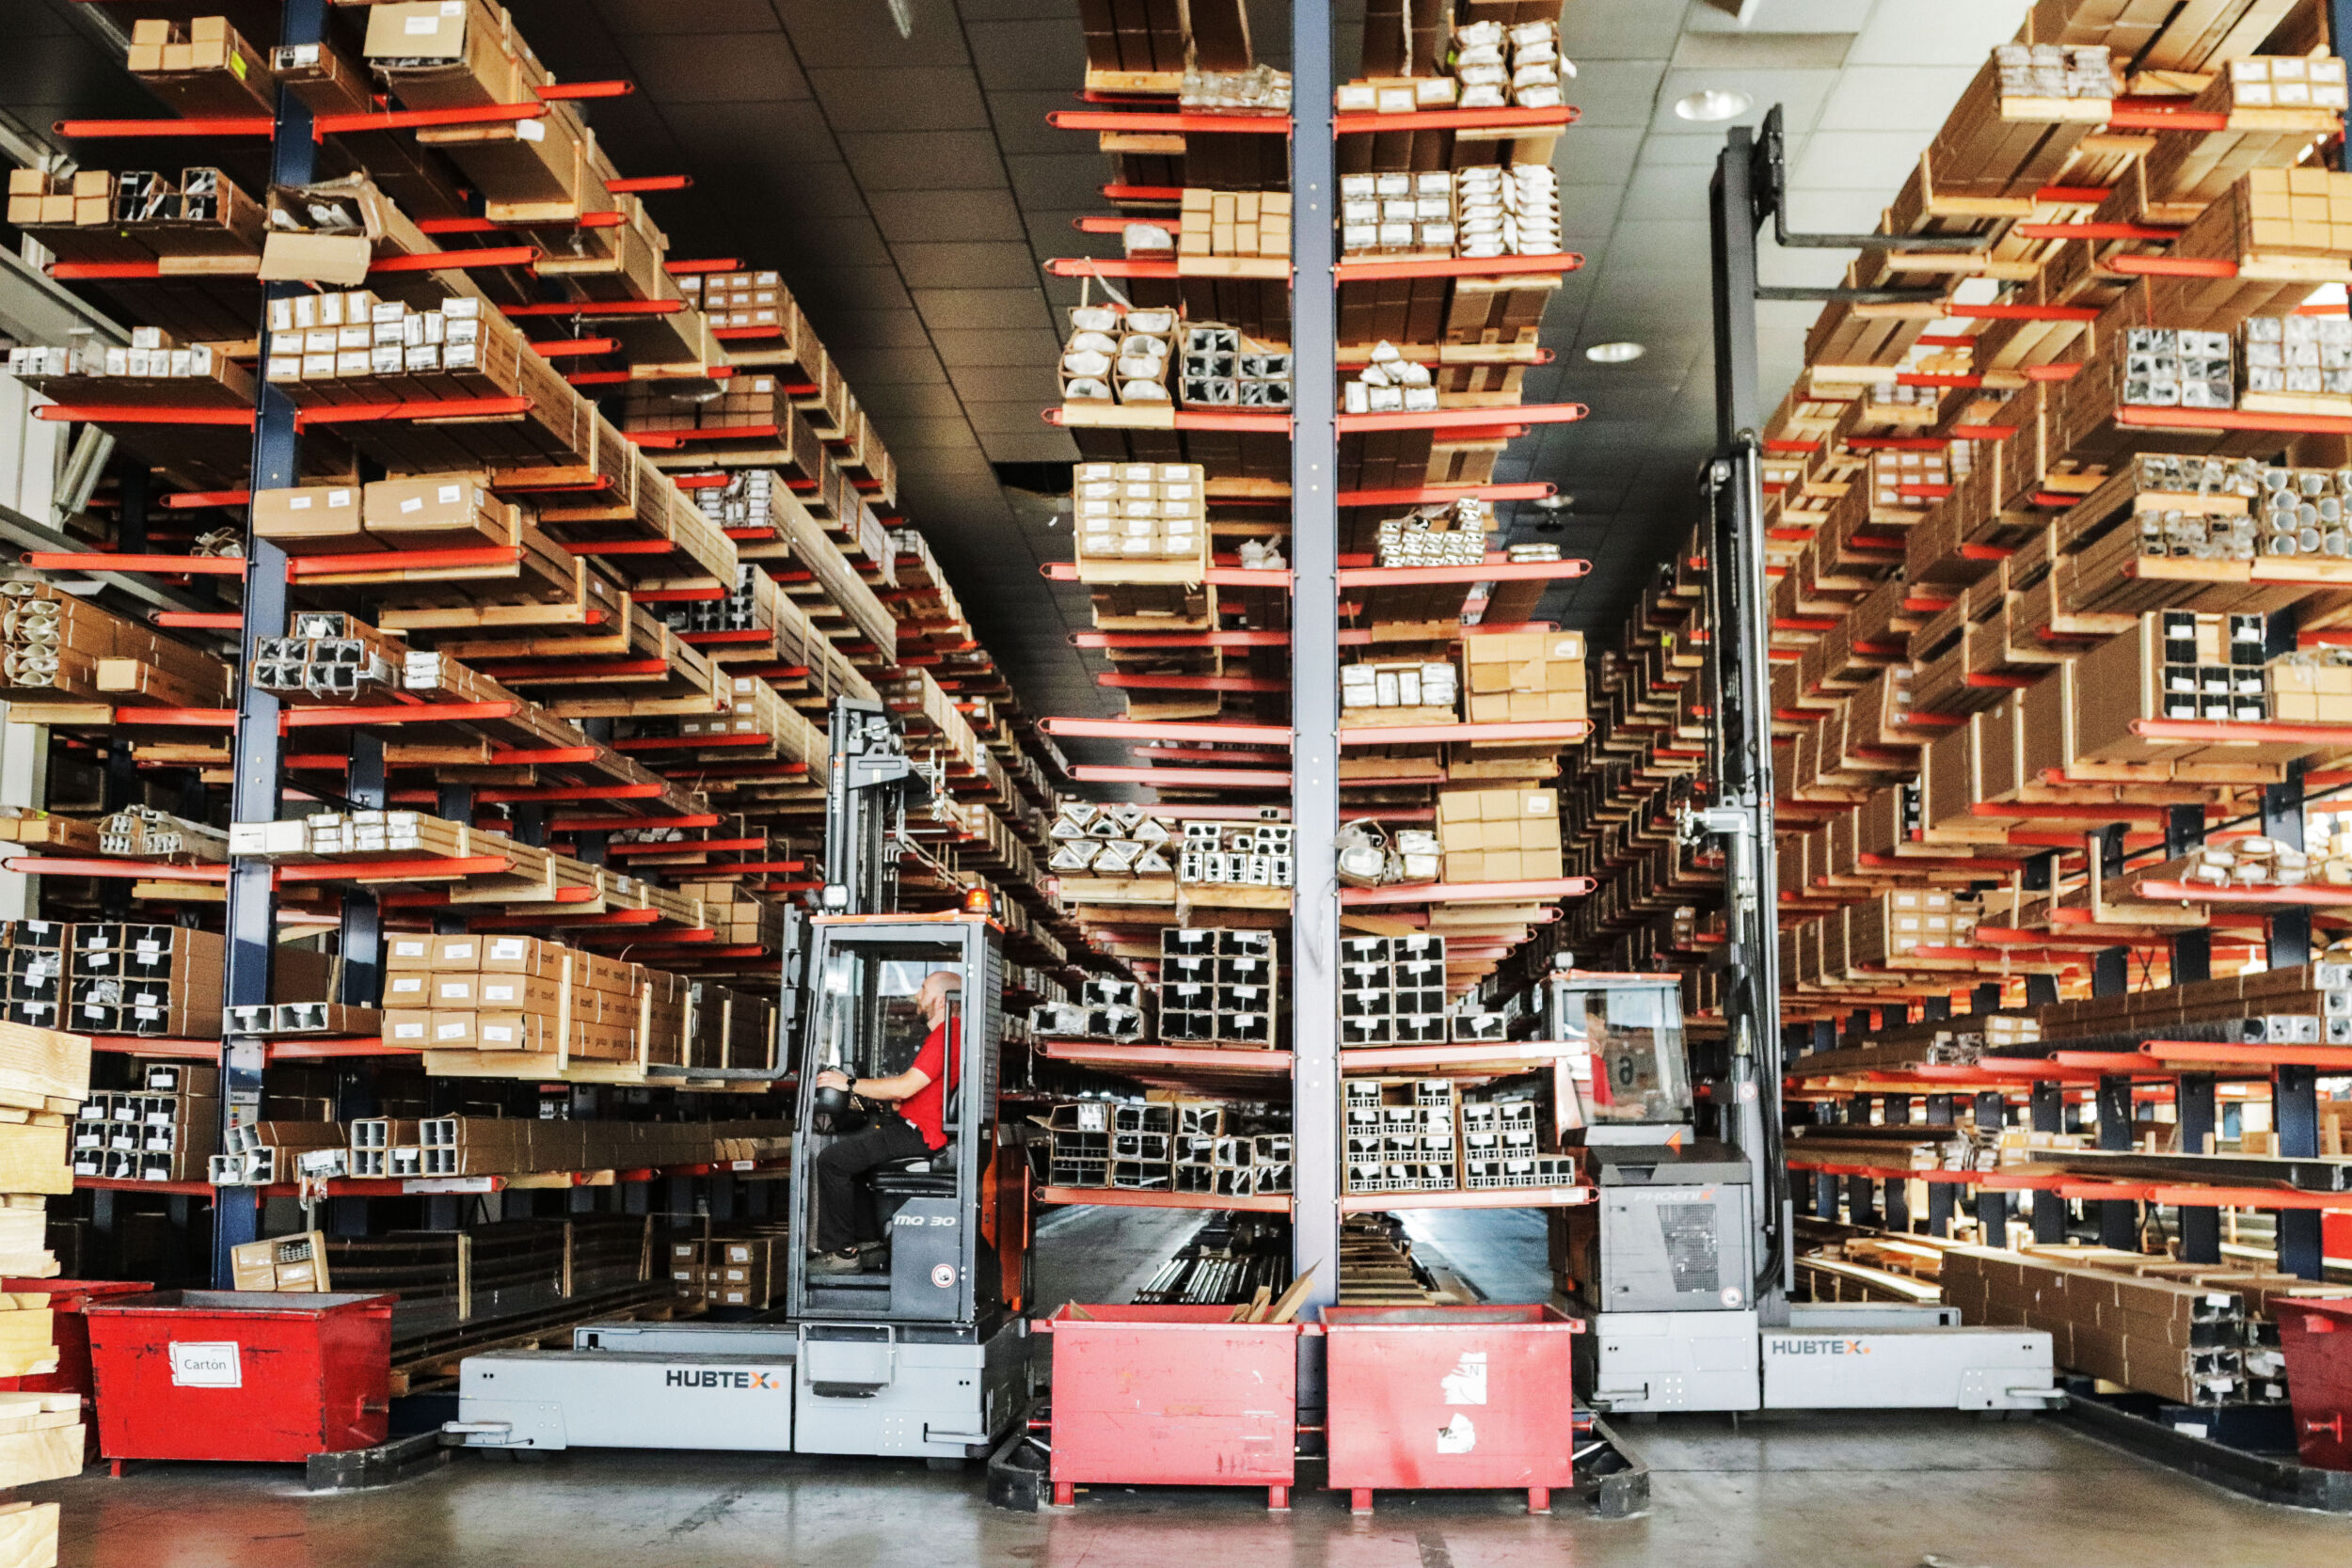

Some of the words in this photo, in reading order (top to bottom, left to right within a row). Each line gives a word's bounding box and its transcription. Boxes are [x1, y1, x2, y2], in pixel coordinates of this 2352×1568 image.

[1634, 1187, 1716, 1201] PHOENIX
[894, 1215, 925, 1226] MQ
[930, 1216, 957, 1227] 30
[183, 1358, 227, 1370] Cartón
